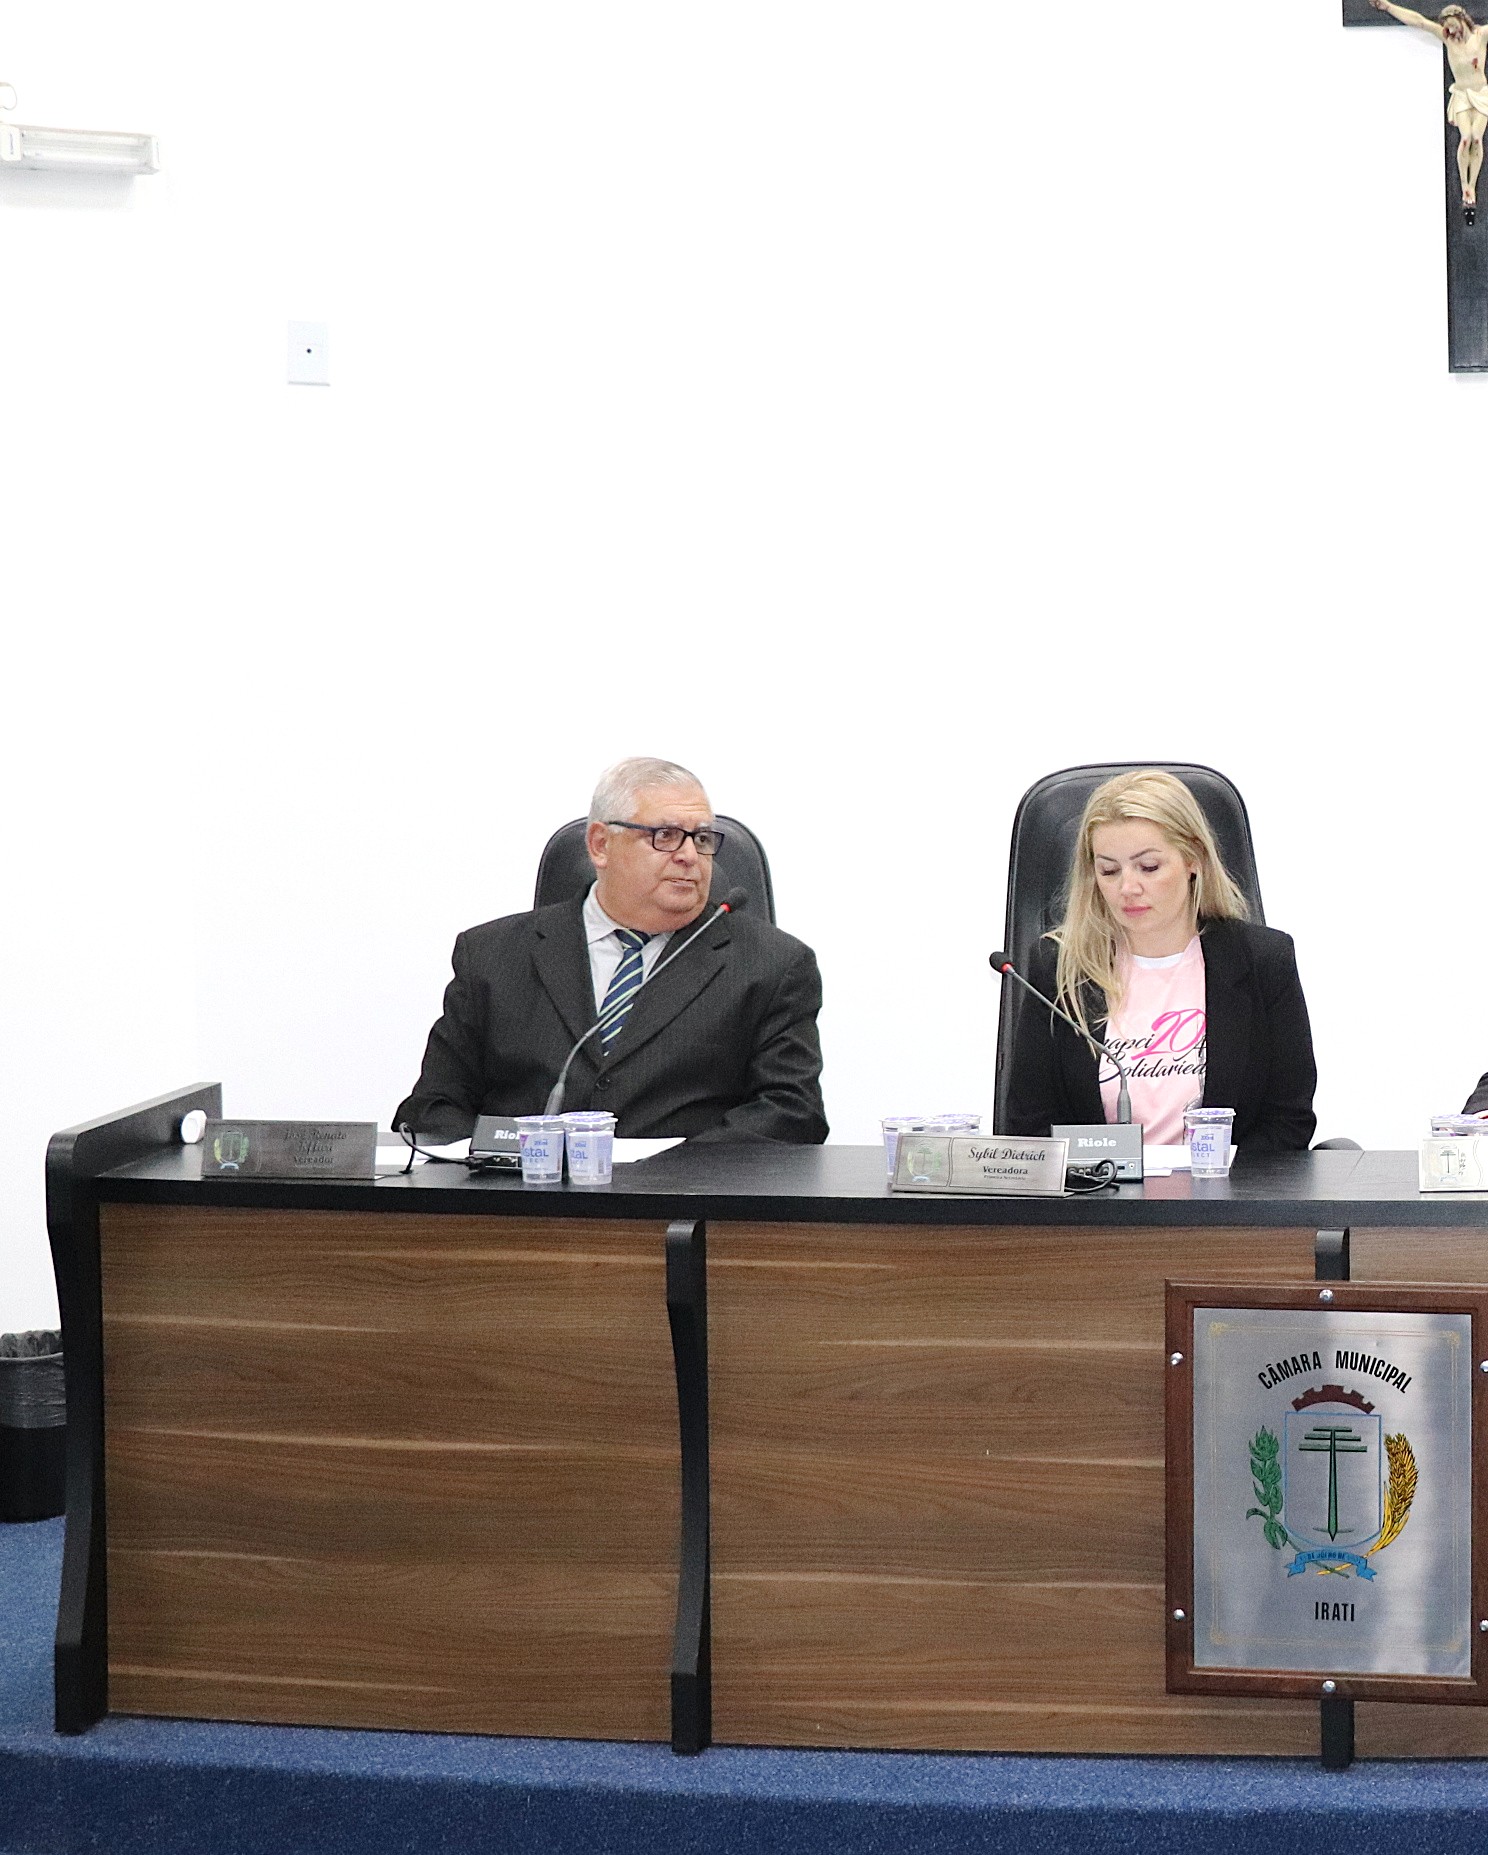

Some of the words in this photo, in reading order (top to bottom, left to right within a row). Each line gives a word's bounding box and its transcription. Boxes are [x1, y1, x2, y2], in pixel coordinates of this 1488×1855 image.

[494, 1129, 520, 1140] Riol
[1077, 1136, 1117, 1148] Riole
[968, 1146, 1000, 1161] Sybil
[1001, 1147, 1046, 1161] Dietrich
[983, 1165, 1028, 1175] Vereadora
[1257, 1350, 1322, 1390] CÂMARA
[1335, 1350, 1412, 1394] MUNICIPAL
[1314, 1601, 1356, 1622] IRATI
